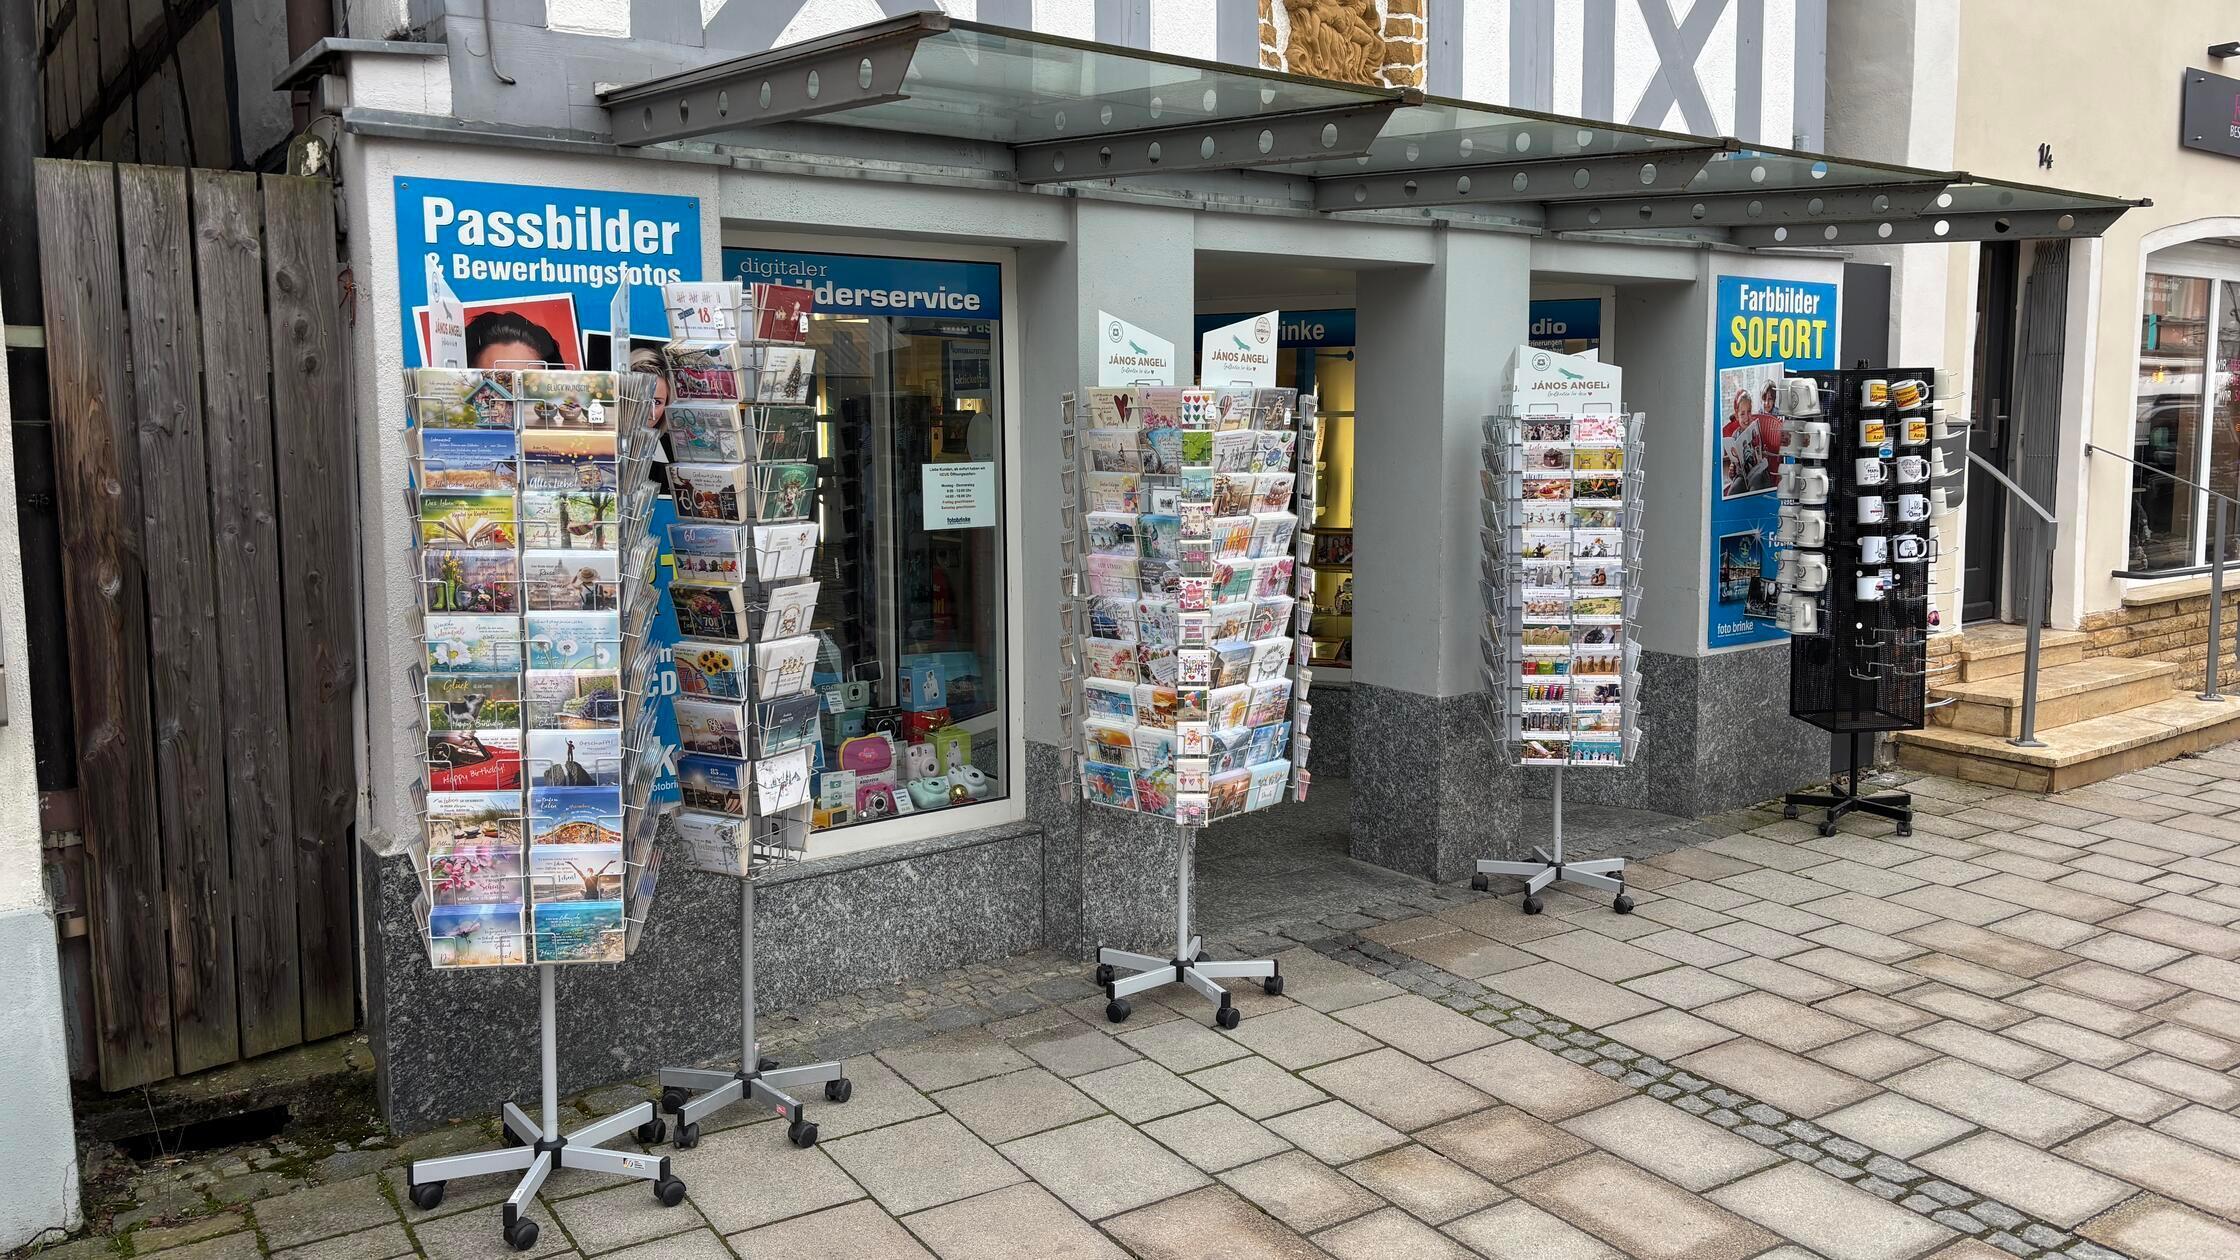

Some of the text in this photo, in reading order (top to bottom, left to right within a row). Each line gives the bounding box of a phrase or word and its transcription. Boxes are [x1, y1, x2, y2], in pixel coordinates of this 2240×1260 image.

[2038, 142, 2053, 170] 14
[422, 196, 680, 255] Passbilder
[453, 253, 681, 288] Bewerbungsfotos
[740, 258, 828, 278] digitaler
[1740, 284, 1820, 314] Farbbilder
[698, 307, 711, 323] 18
[1531, 318, 1567, 335] dio
[1730, 316, 1827, 359] SOFORT
[1109, 354, 1137, 366] JÁNOS
[1211, 350, 1239, 362] JÁNOS
[1532, 380, 1568, 390] JÁNOS
[672, 408, 697, 429] 50
[1717, 620, 1754, 635] foto brinke
[443, 678, 470, 692] Glück
[452, 719, 472, 729] Happy
[442, 773, 468, 785] Happy
